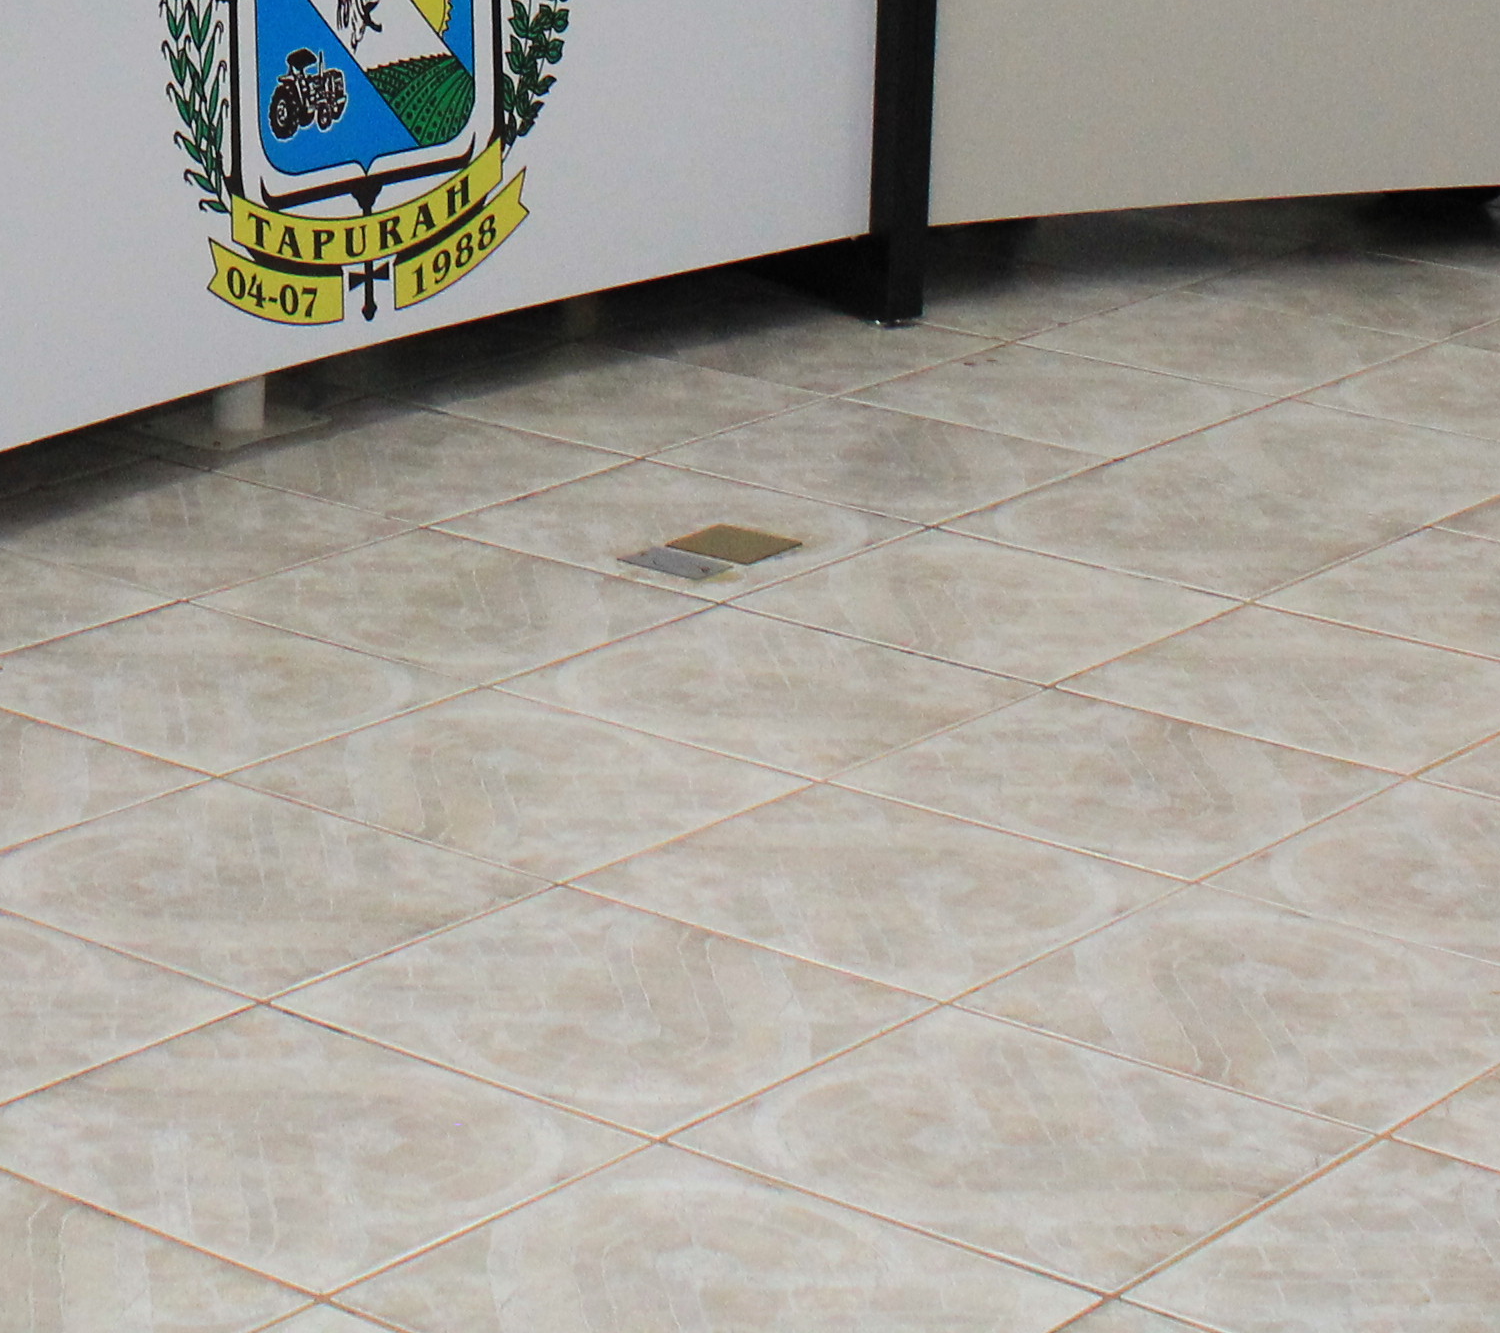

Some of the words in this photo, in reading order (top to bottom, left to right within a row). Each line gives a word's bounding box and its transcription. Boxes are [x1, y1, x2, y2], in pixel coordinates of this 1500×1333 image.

[246, 174, 472, 260] TAPURAH
[411, 213, 498, 299] 1988
[226, 265, 319, 320] 04-07
